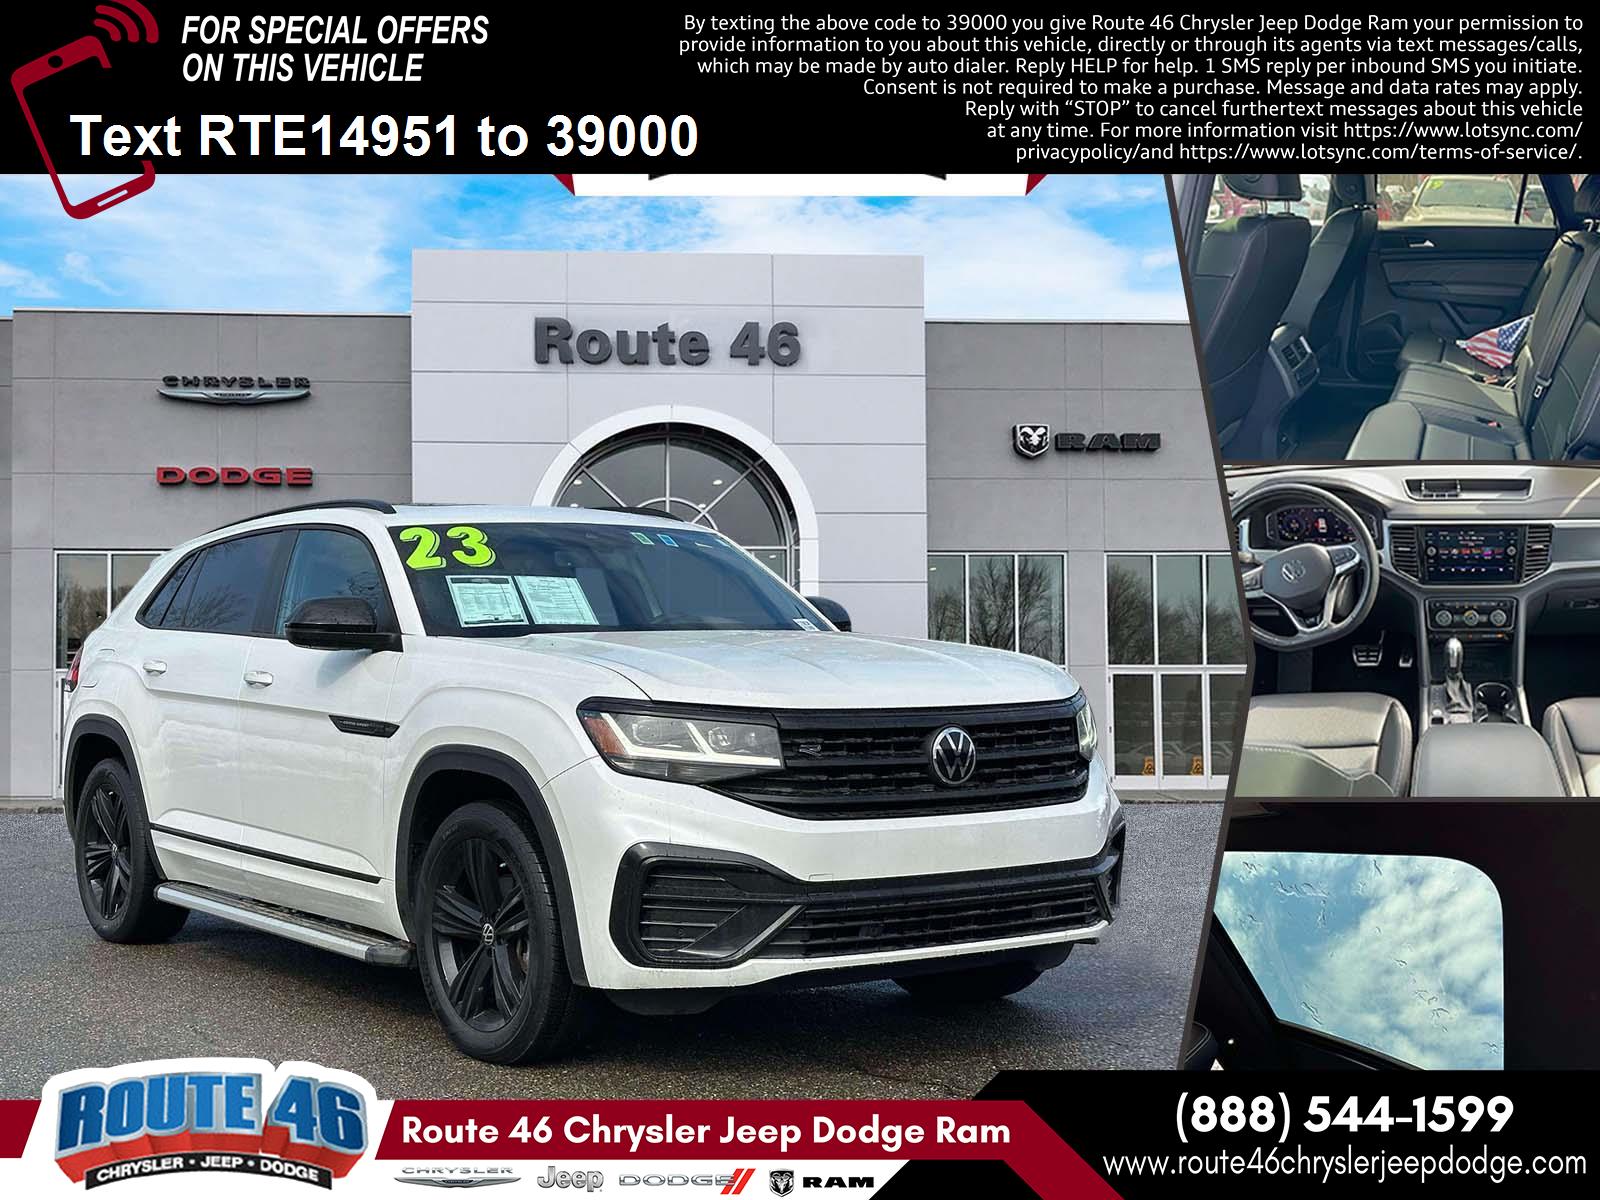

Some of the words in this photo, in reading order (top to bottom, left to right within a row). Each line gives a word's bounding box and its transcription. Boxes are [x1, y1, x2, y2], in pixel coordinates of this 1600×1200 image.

[534, 317, 710, 365] Route
[730, 321, 801, 366] 46
[162, 375, 311, 389] CHRYSLER
[1054, 432, 1161, 453] RAM
[156, 466, 314, 486] DODGE
[398, 526, 497, 571] 23
